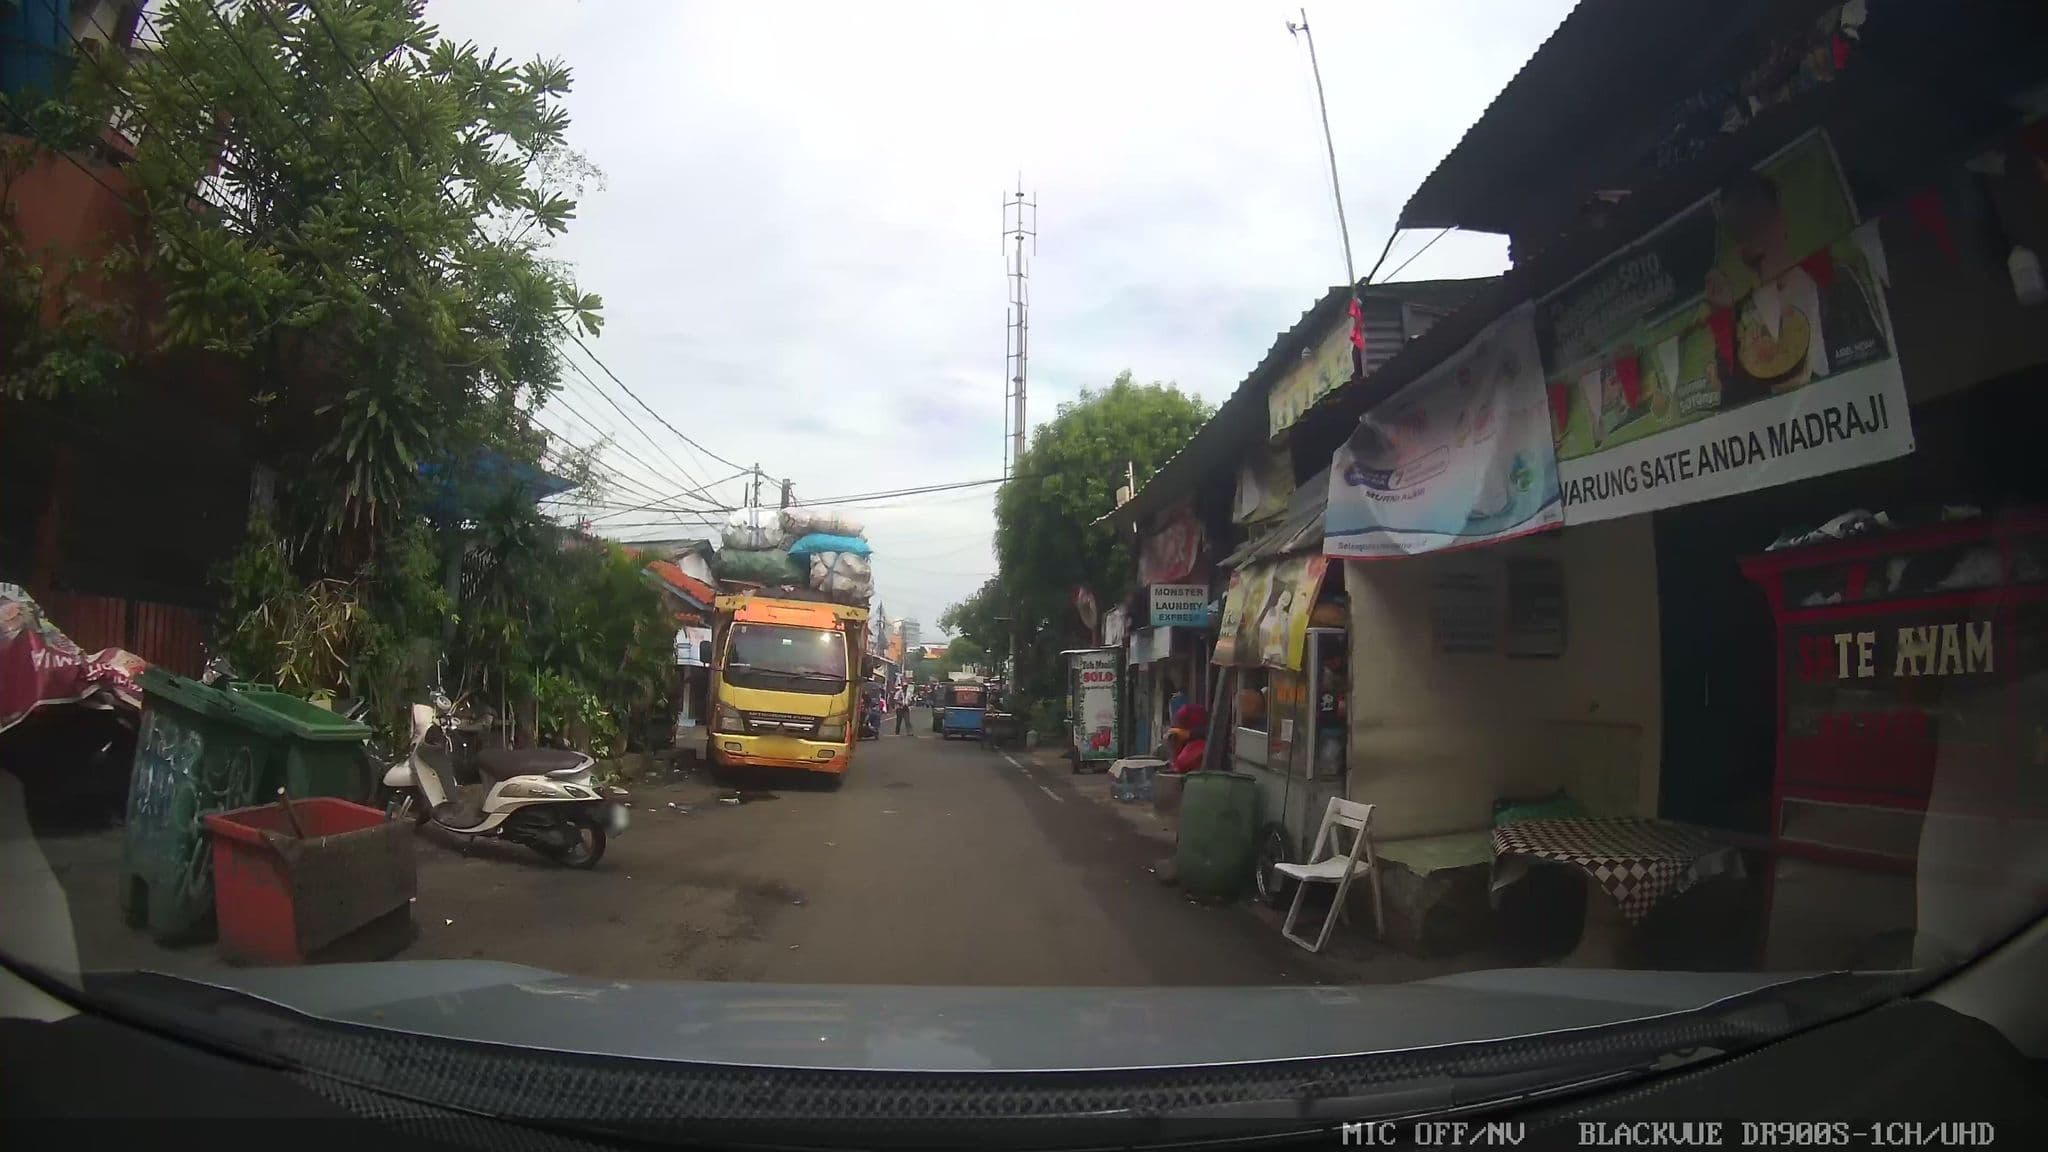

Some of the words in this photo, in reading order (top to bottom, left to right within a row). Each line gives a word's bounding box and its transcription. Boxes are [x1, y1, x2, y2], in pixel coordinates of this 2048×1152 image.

[1642, 450, 1693, 489] SATE
[1698, 431, 1765, 477] ANDA
[1767, 393, 1888, 457] MADRAJI
[1154, 588, 1204, 597] MONSTER
[1155, 602, 1203, 610] LAUNDRY
[1894, 620, 1993, 677] AYAM
[1083, 671, 1114, 683] SOLO
